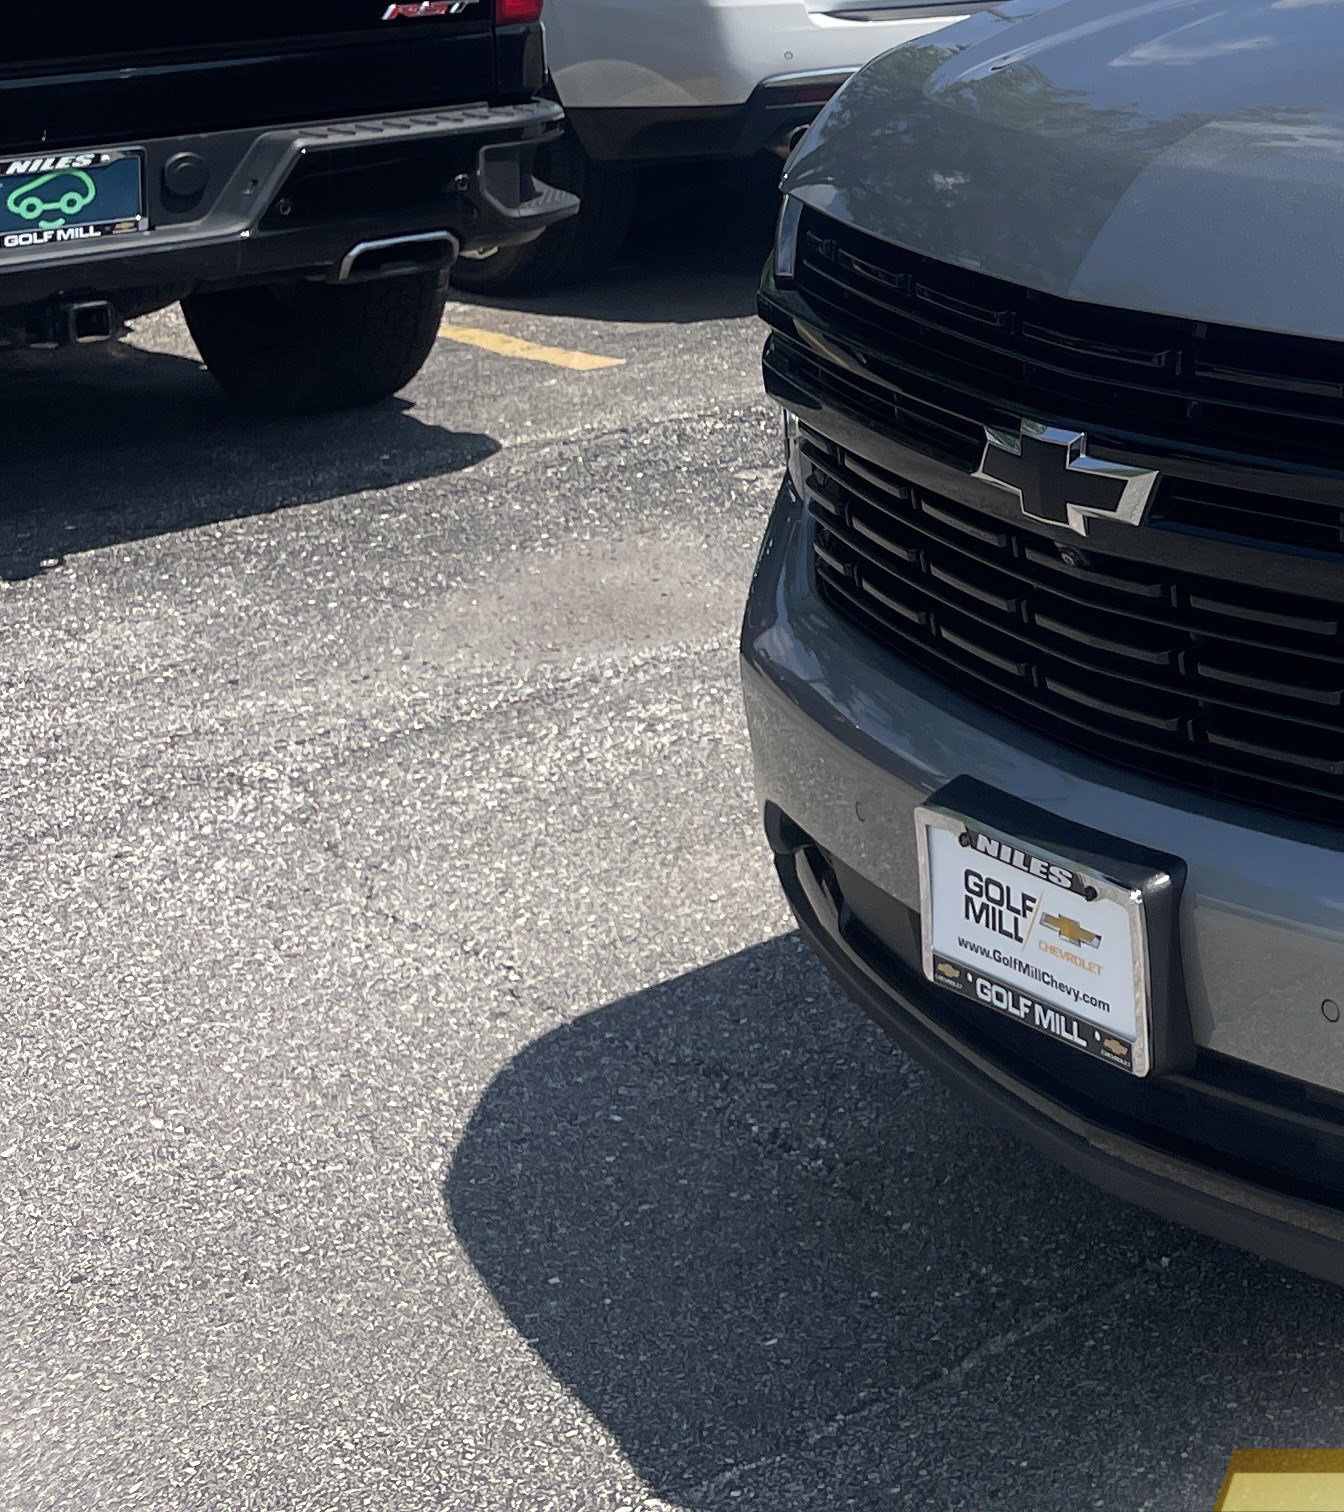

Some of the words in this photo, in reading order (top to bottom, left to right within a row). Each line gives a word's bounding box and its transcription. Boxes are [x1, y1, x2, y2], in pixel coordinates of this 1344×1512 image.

[5, 153, 95, 175] NILES
[4, 231, 55, 248] GOLF
[57, 226, 102, 241] MILL
[975, 833, 1073, 890] NILES
[963, 868, 1037, 919] GOLF
[964, 893, 1024, 944] MILL
[957, 935, 1112, 1014] www.GolfMillChevy.com
[1037, 939, 1104, 977] CHEVROLET
[975, 977, 1032, 1020] GOLF
[1034, 1005, 1088, 1048] MILL
